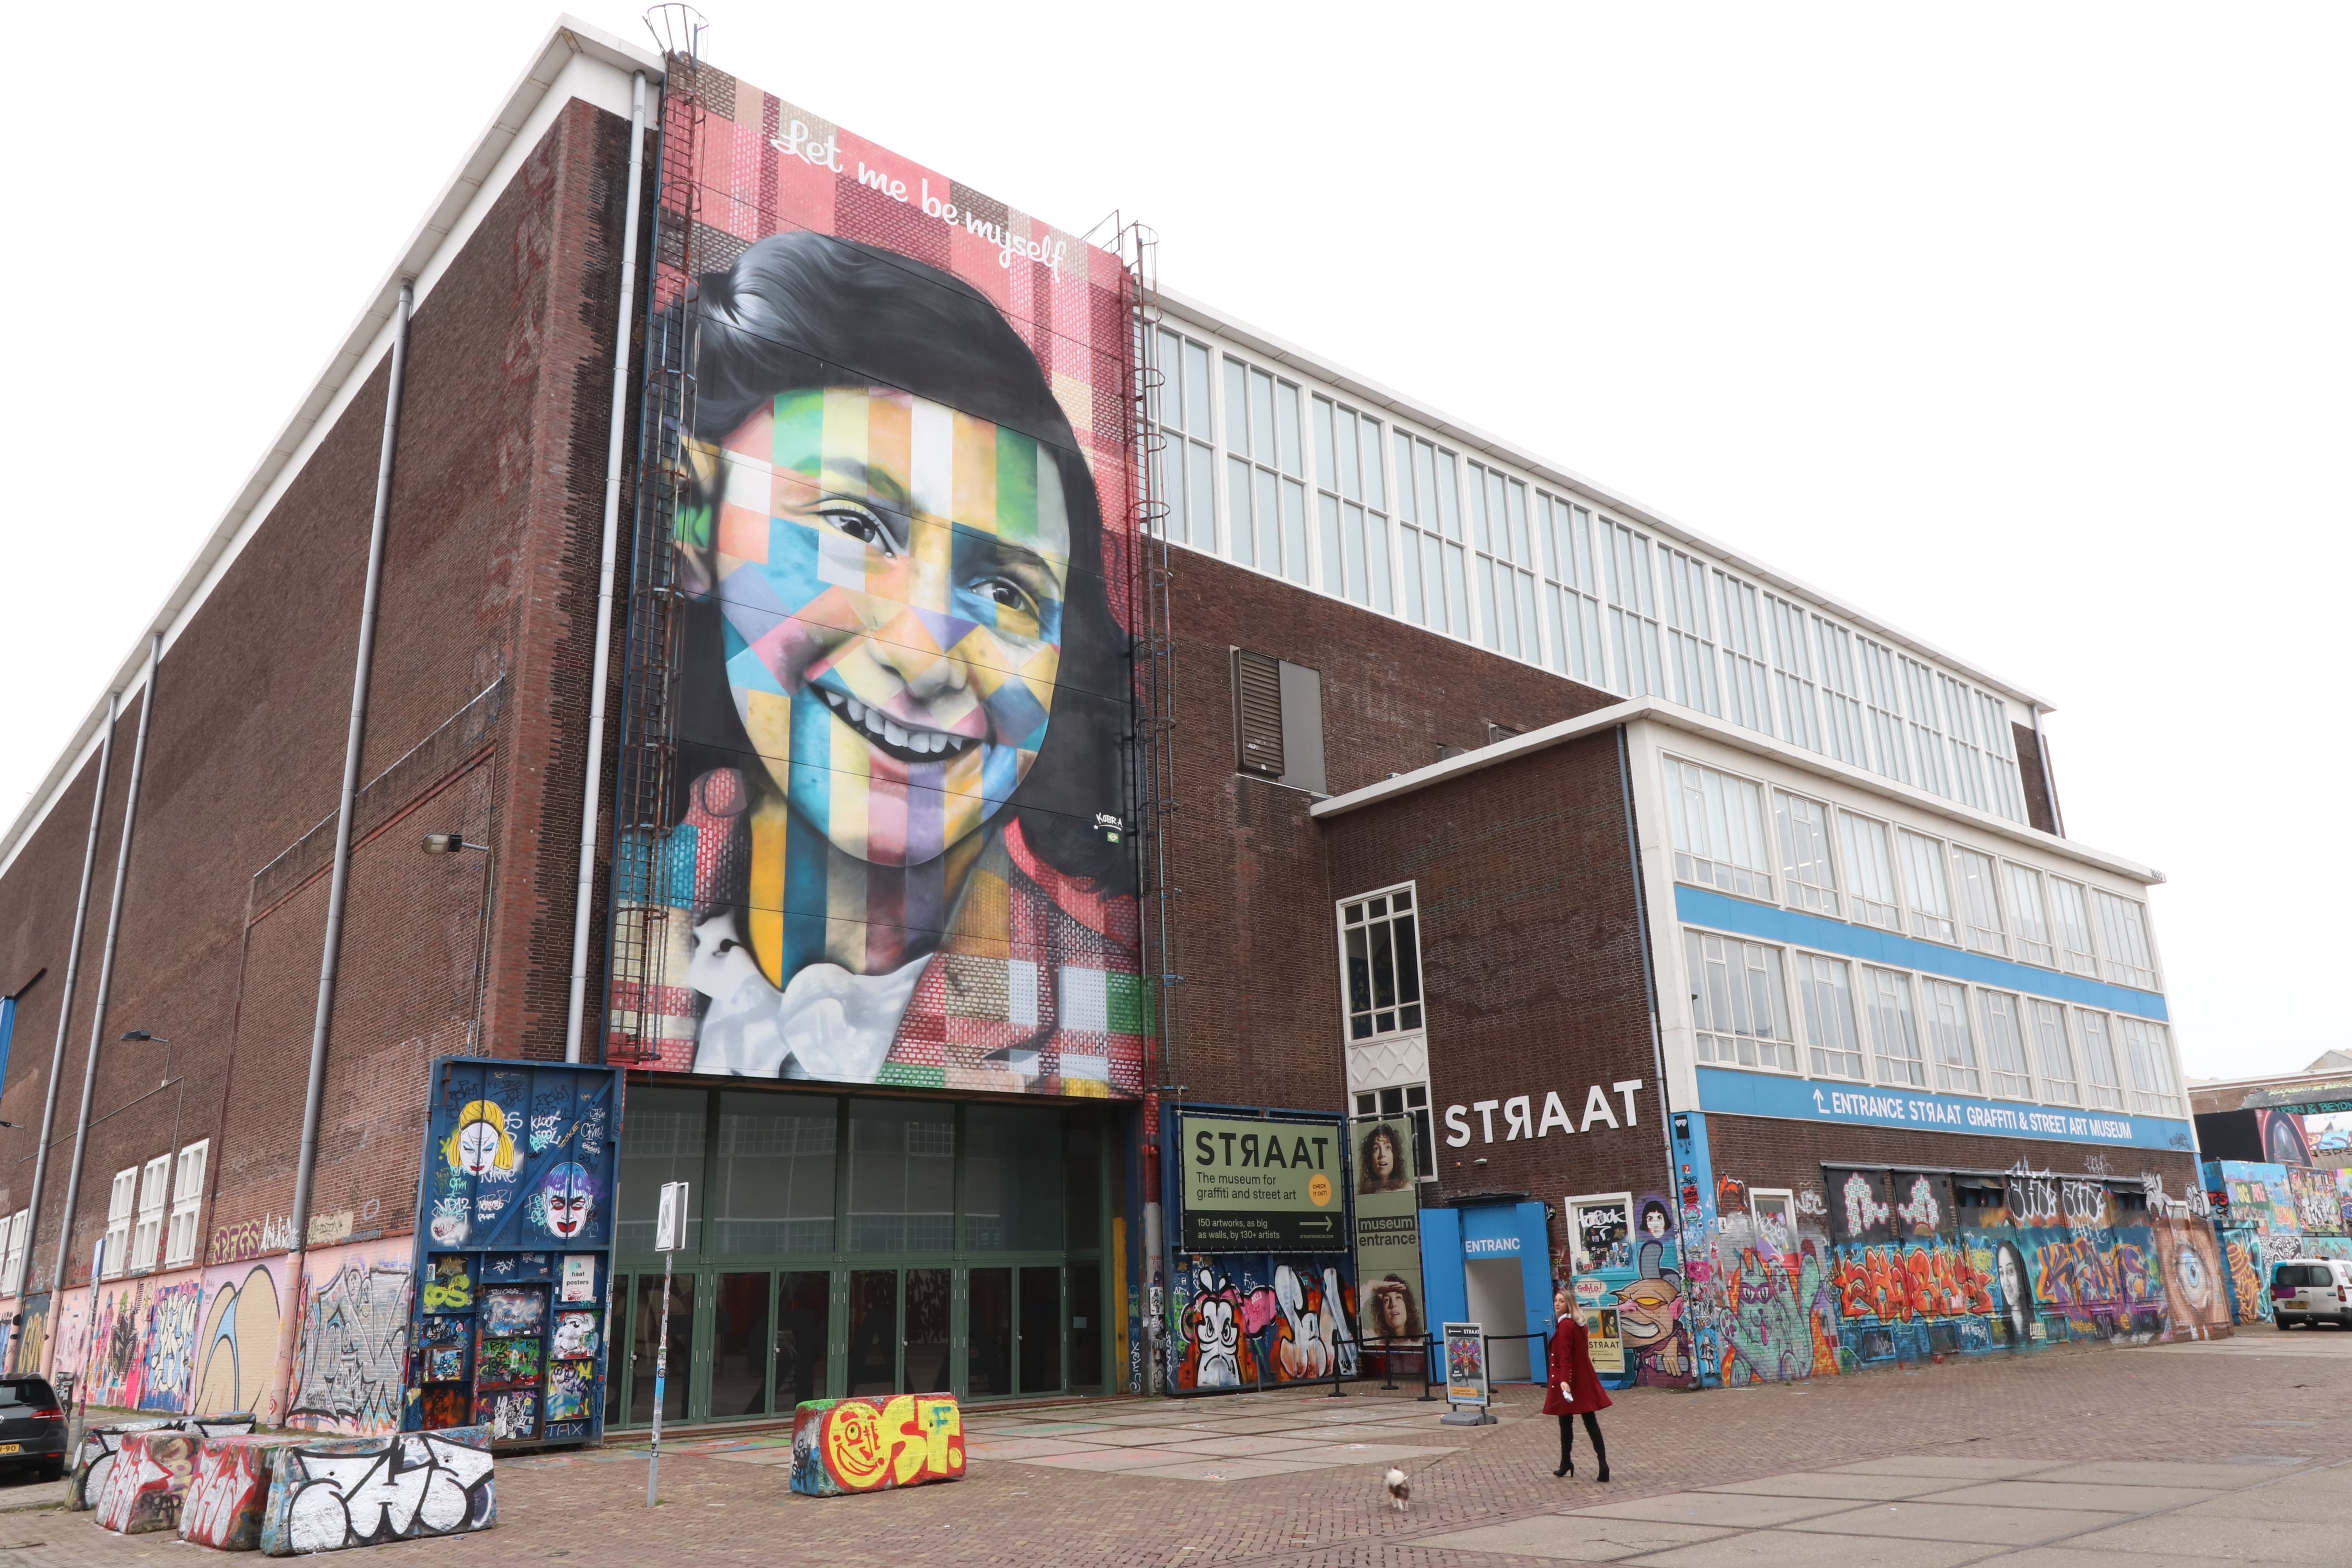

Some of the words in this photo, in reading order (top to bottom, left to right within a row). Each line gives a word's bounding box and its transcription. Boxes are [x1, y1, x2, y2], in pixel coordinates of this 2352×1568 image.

[769, 120, 843, 173] Let
[858, 161, 908, 203] me
[921, 178, 959, 226] be
[966, 211, 1067, 283] myself
[1096, 812, 1123, 828] KOBRA
[1445, 1079, 1642, 1147] STRAAT
[1831, 1092, 1906, 1120] ENTRANCE
[1966, 1106, 2018, 1129] GRAFFITI
[2019, 1112, 2029, 1131] &
[2029, 1112, 2067, 1134] STREET
[2069, 1117, 2088, 1136] ART
[2089, 1118, 2132, 1140] MUSEUM
[2307, 1103, 2318, 1115] &
[1196, 1131, 1328, 1169] STRAAT
[1196, 1172, 1216, 1183] The
[1218, 1175, 1260, 1185] museum
[1263, 1174, 1276, 1185] for
[1197, 1187, 1229, 1201] graffiti
[1232, 1188, 1250, 1199] and
[1253, 1189, 1281, 1200] street
[1283, 1190, 1297, 1200] art
[1198, 1218, 1210, 1227] 150
[1212, 1219, 1245, 1228] artworks,
[1256, 1219, 1268, 1229] big
[1360, 1218, 1413, 1231] museum
[1208, 1231, 1229, 1240] walls,
[1230, 1231, 1239, 1241] by
[1258, 1230, 1280, 1239] artists
[1359, 1233, 1416, 1247] entrance
